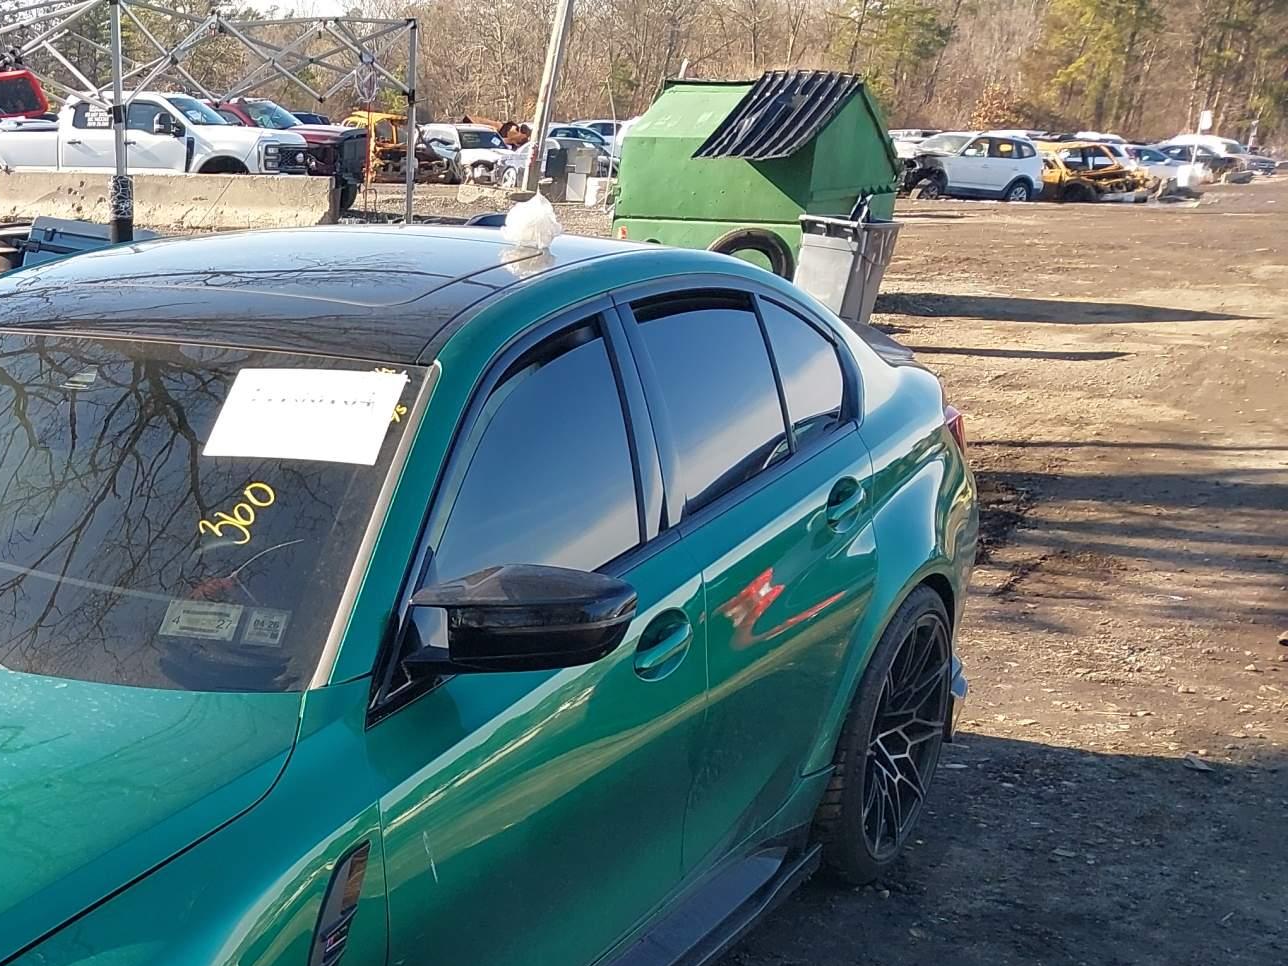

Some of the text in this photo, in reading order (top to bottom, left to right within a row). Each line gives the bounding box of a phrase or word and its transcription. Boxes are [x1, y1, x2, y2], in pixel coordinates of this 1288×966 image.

[198, 482, 275, 545] 360
[172, 615, 181, 625] 4
[215, 619, 233, 630] 27
